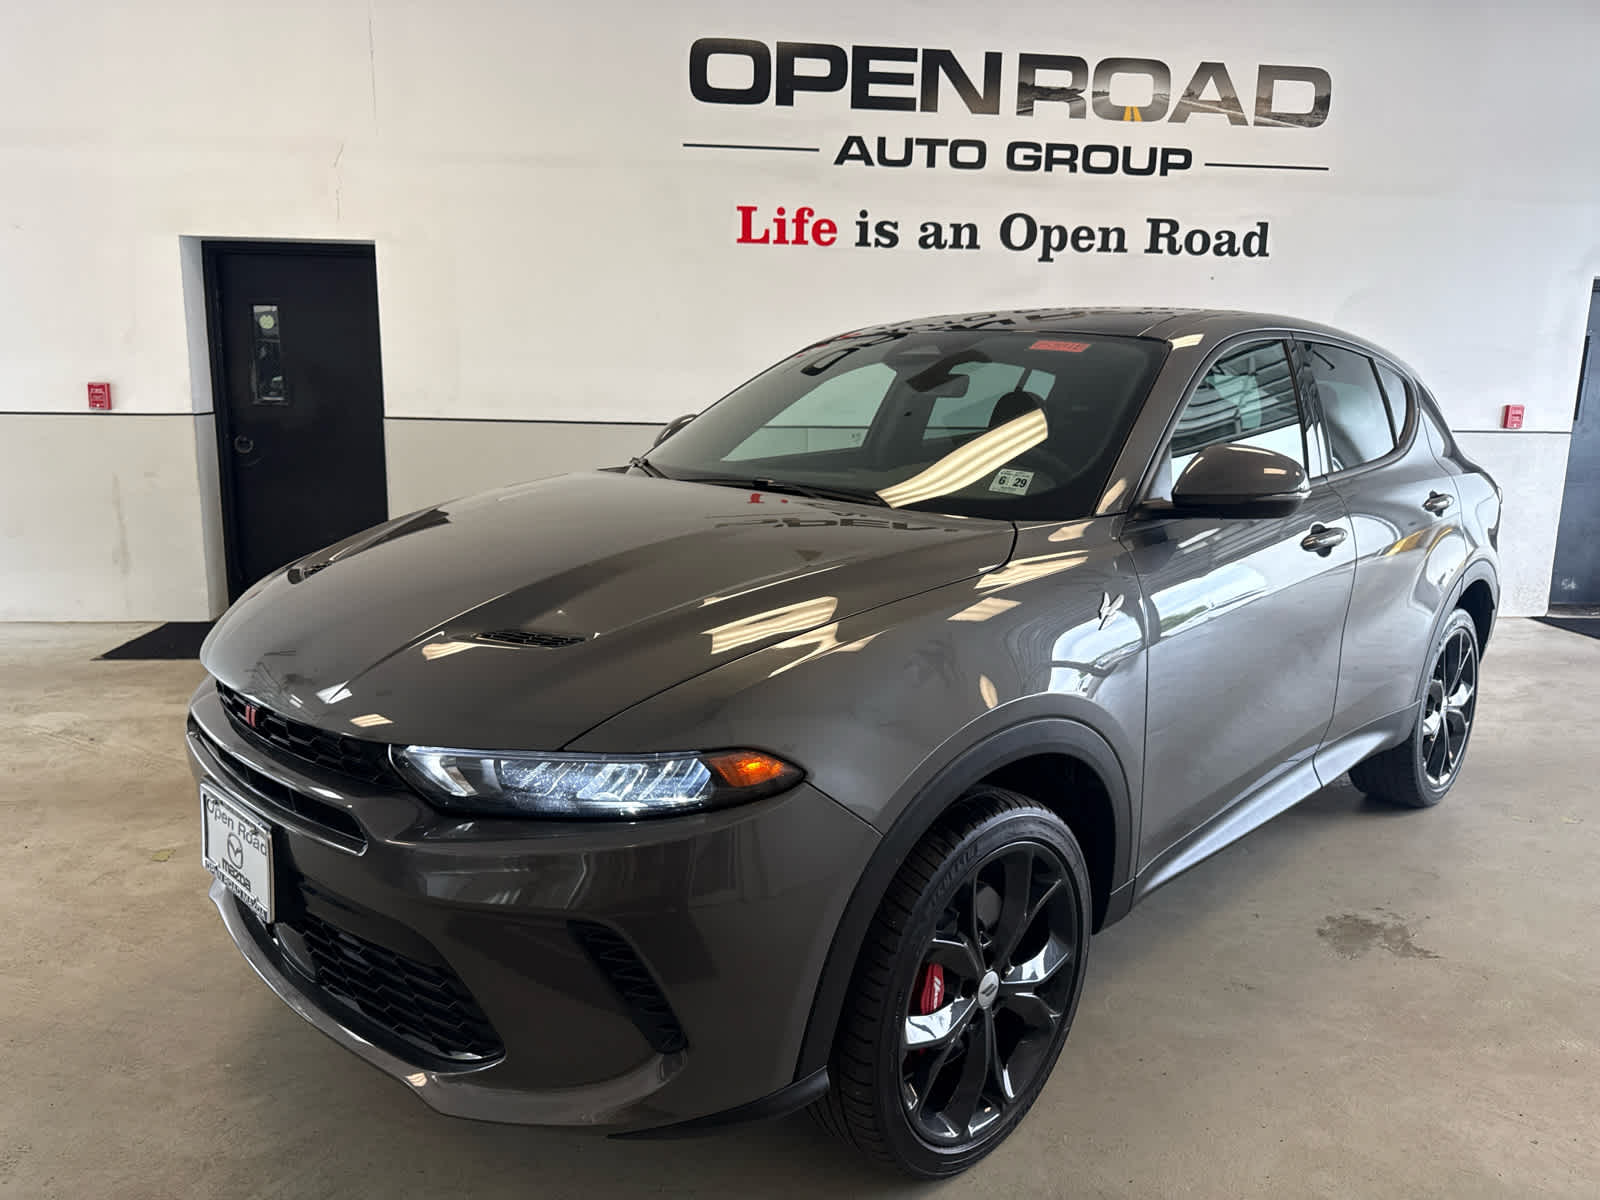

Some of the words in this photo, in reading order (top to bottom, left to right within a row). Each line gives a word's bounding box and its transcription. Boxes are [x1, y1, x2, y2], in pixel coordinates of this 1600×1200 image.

[689, 38, 1002, 115] OPEN
[1016, 53, 1331, 128] ROAD
[834, 136, 986, 169] AUTO
[1006, 141, 1192, 176] GROUP
[736, 206, 837, 246] Life
[855, 209, 899, 248] is
[919, 221, 981, 250] an
[1000, 212, 1128, 262] Open
[1144, 217, 1269, 257] Road
[998, 475, 1007, 485] 6
[1012, 477, 1028, 488] 29
[206, 798, 234, 830] Open
